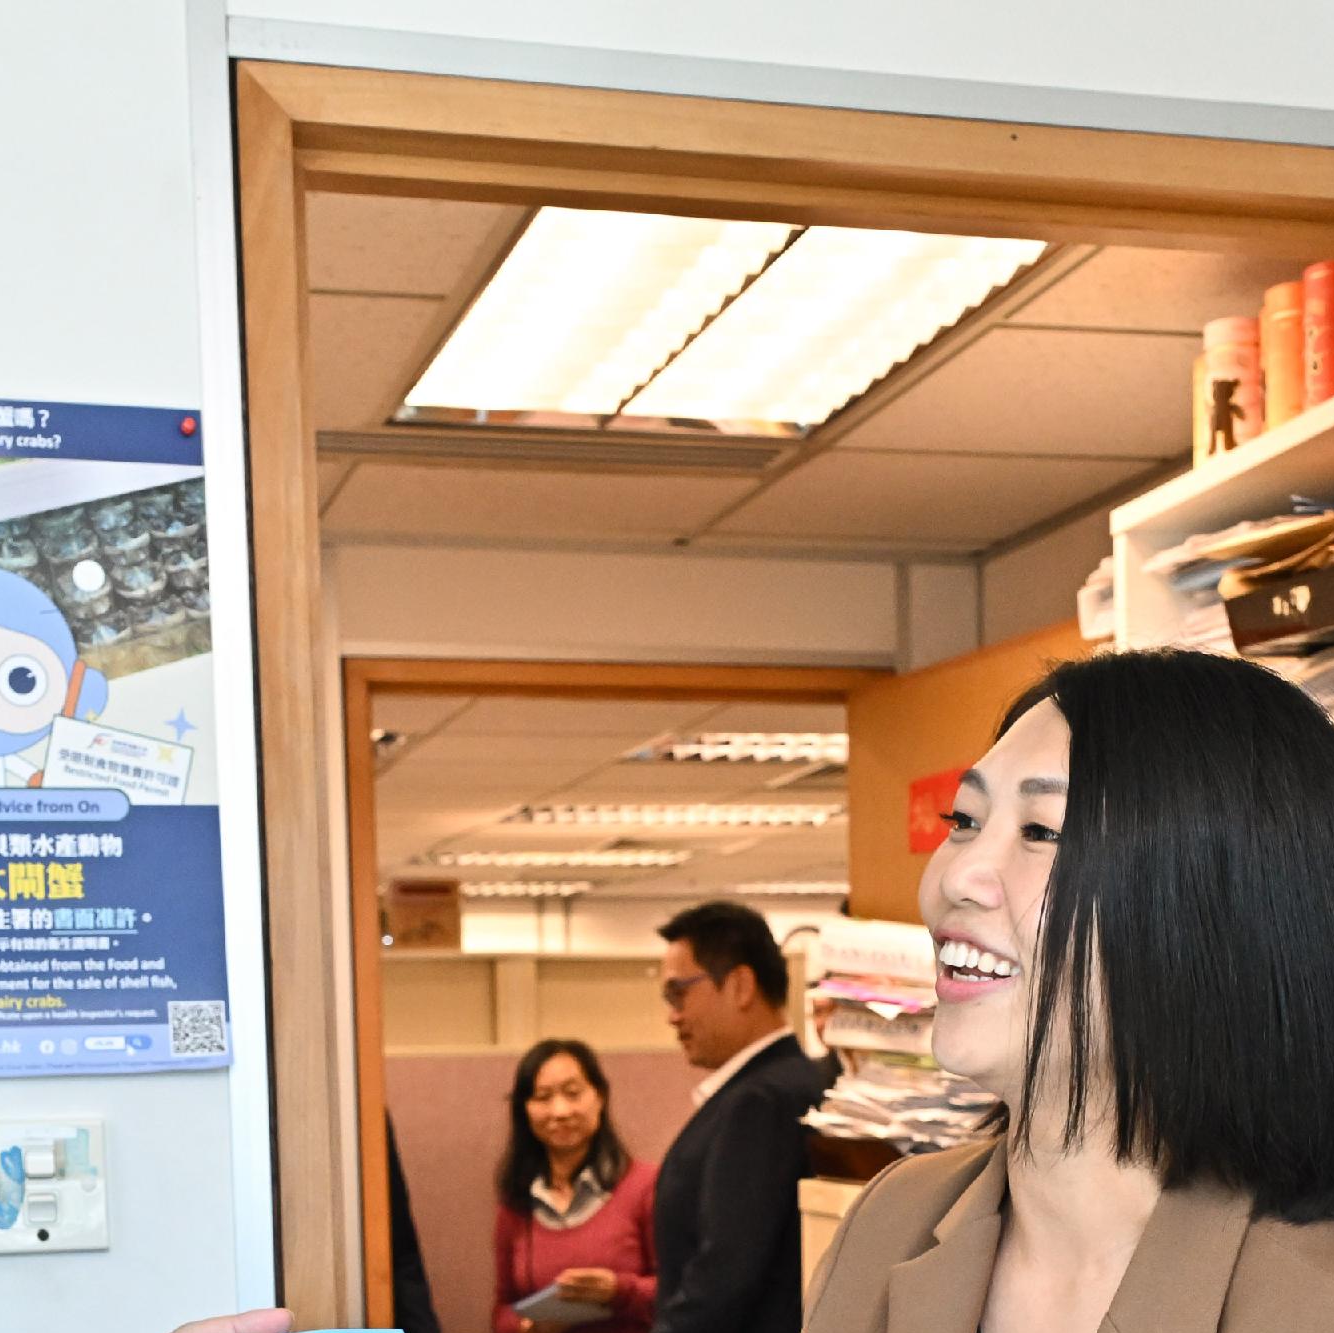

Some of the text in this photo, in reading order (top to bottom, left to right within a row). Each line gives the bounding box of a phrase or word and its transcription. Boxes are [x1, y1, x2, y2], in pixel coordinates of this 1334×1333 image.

[17, 433, 61, 449] crabs?
[37, 800, 73, 813] from
[78, 800, 99, 813] On
[51, 958, 82, 972] from
[84, 957, 105, 971] the
[107, 957, 139, 970] Food
[141, 956, 165, 970] and
[32, 976, 50, 990] for
[52, 976, 74, 990] the
[77, 976, 102, 990] sale
[104, 975, 117, 989] of
[120, 975, 149, 989] shell
[26, 994, 66, 1009] crabs.
